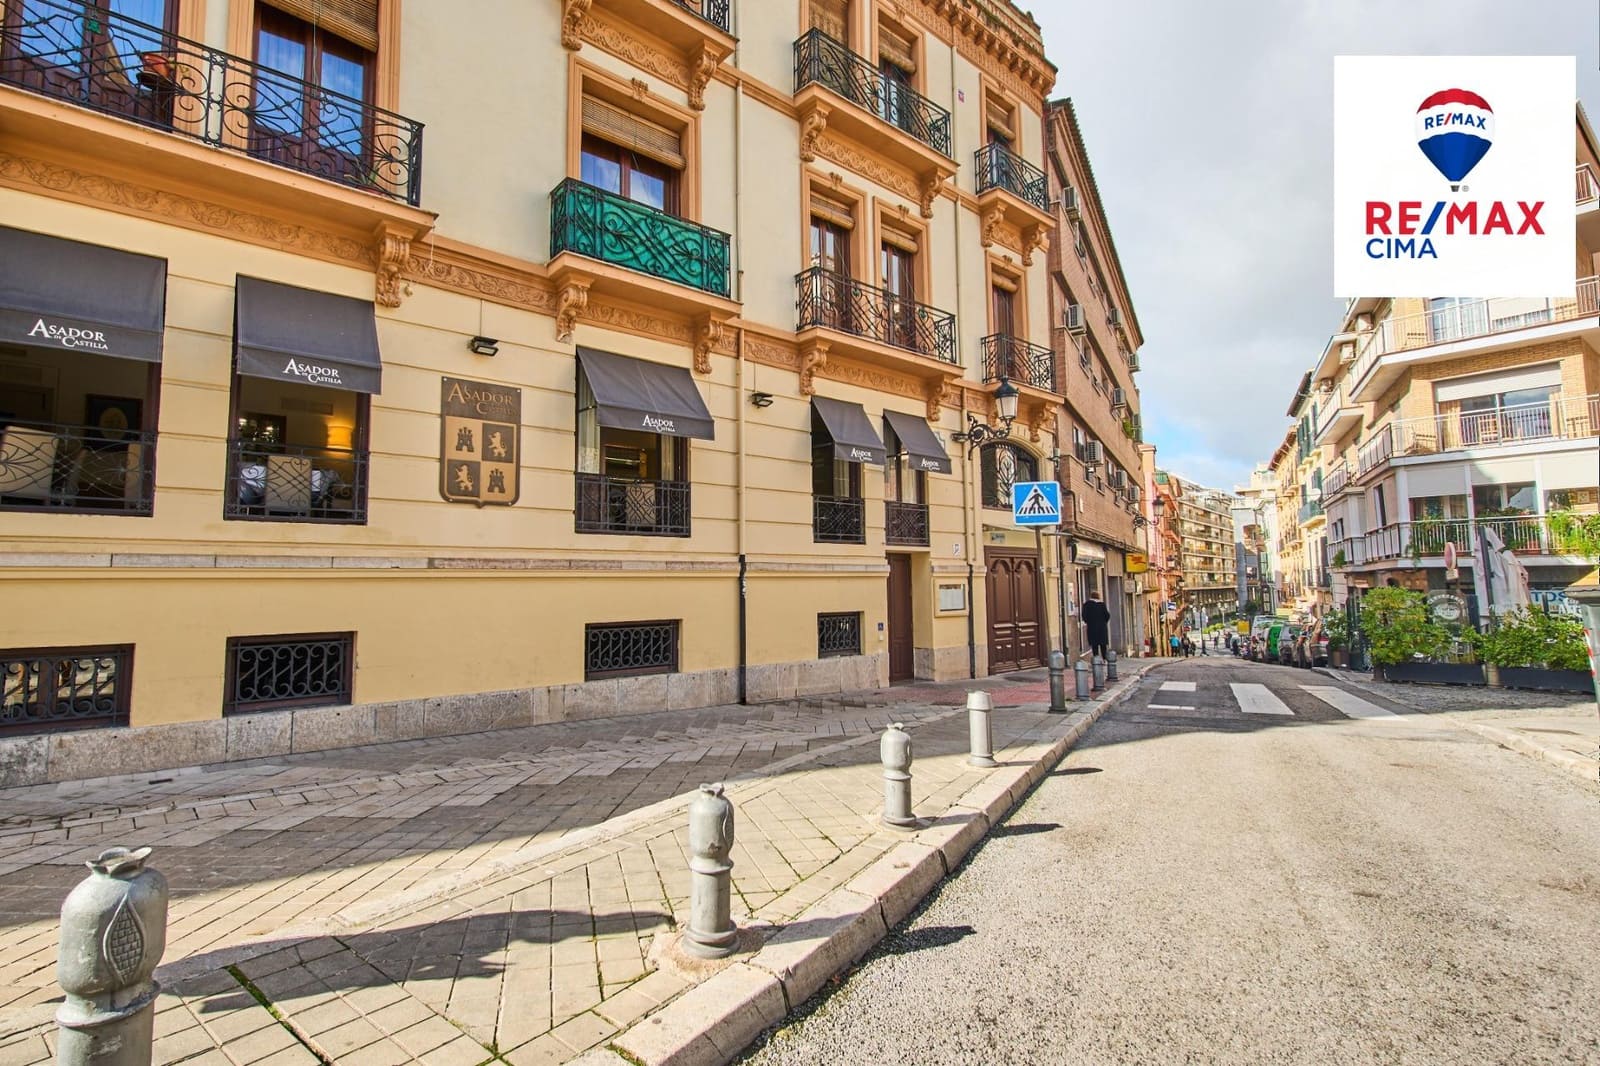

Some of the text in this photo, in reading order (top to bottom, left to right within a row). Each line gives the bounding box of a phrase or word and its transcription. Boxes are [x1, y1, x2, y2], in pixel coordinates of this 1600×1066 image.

[27, 318, 106, 343] ASADOR
[62, 336, 108, 350] CASTILLA
[283, 358, 340, 378] ASADOR
[447, 382, 513, 405] ASADOR
